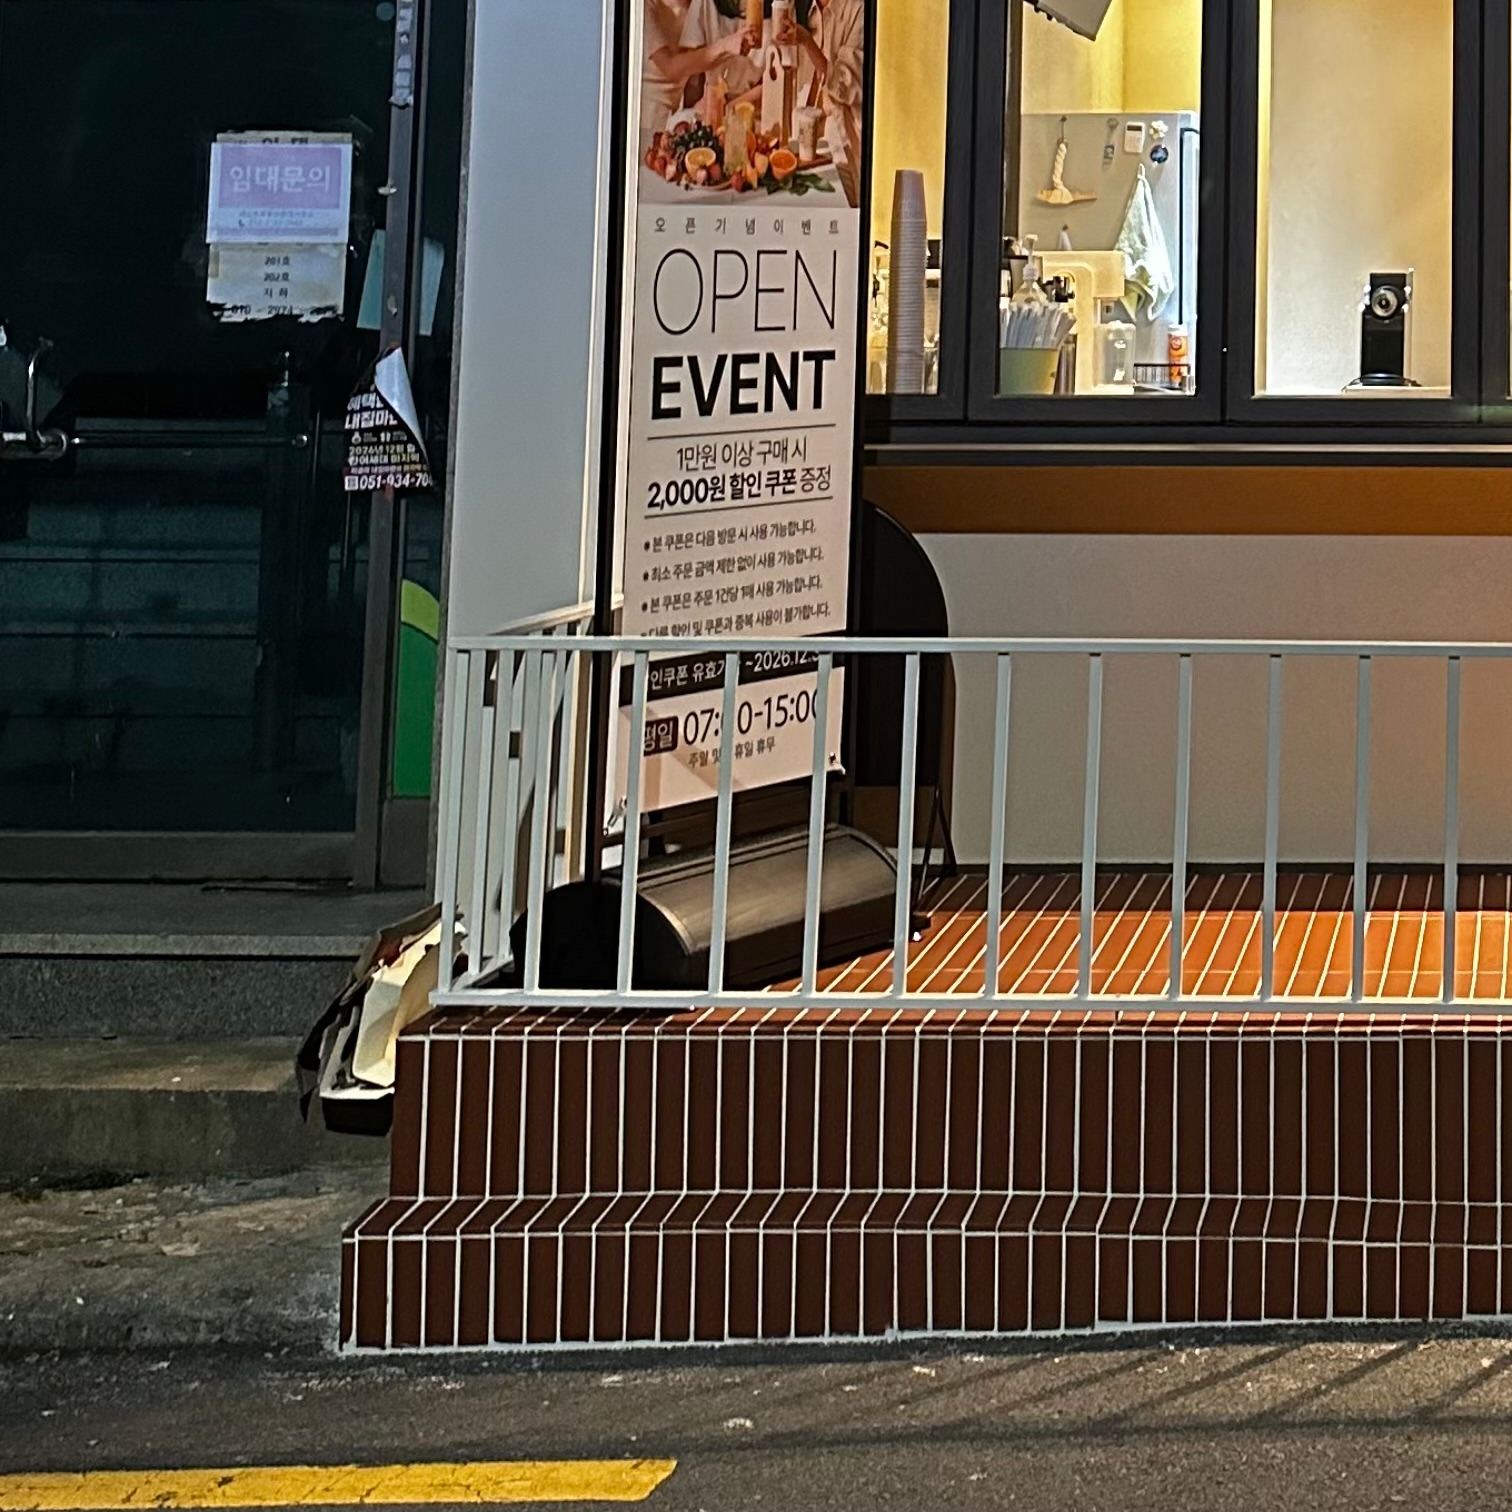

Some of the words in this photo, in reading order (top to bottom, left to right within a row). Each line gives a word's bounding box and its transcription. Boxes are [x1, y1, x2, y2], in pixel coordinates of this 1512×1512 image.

[229, 165, 332, 193] 임대문의
[653, 248, 837, 335] OPEN
[651, 350, 836, 420] EVENT
[676, 443, 717, 472] 1만원
[721, 439, 754, 467] 이상
[757, 437, 789, 465] 구매
[791, 435, 807, 461] 시
[647, 474, 726, 510] 2,000원
[729, 471, 762, 500] 할인
[765, 468, 797, 496] 쿠폰
[800, 465, 832, 493] 증정
[664, 532, 694, 551] 쿠폰은
[695, 530, 716, 547] 다음
[717, 527, 737, 545] 방문
[738, 525, 748, 542] 시
[749, 524, 768, 540] 사용
[651, 564, 672, 583] 최소
[672, 561, 693, 580] 주문
[695, 559, 715, 578] 금액
[716, 556, 735, 574] 제한
[737, 553, 756, 572] 없이
[757, 551, 776, 568] 사용
[662, 592, 693, 612] 쿠폰은
[694, 589, 713, 606] 주문
[756, 581, 774, 597] 사용
[705, 615, 733, 636] 쿠폰과
[756, 608, 783, 627] 사용이
[650, 666, 688, 690] 인쿠폰
[683, 689, 817, 745] 07:0-15:0
[735, 740, 753, 760] 휴일
